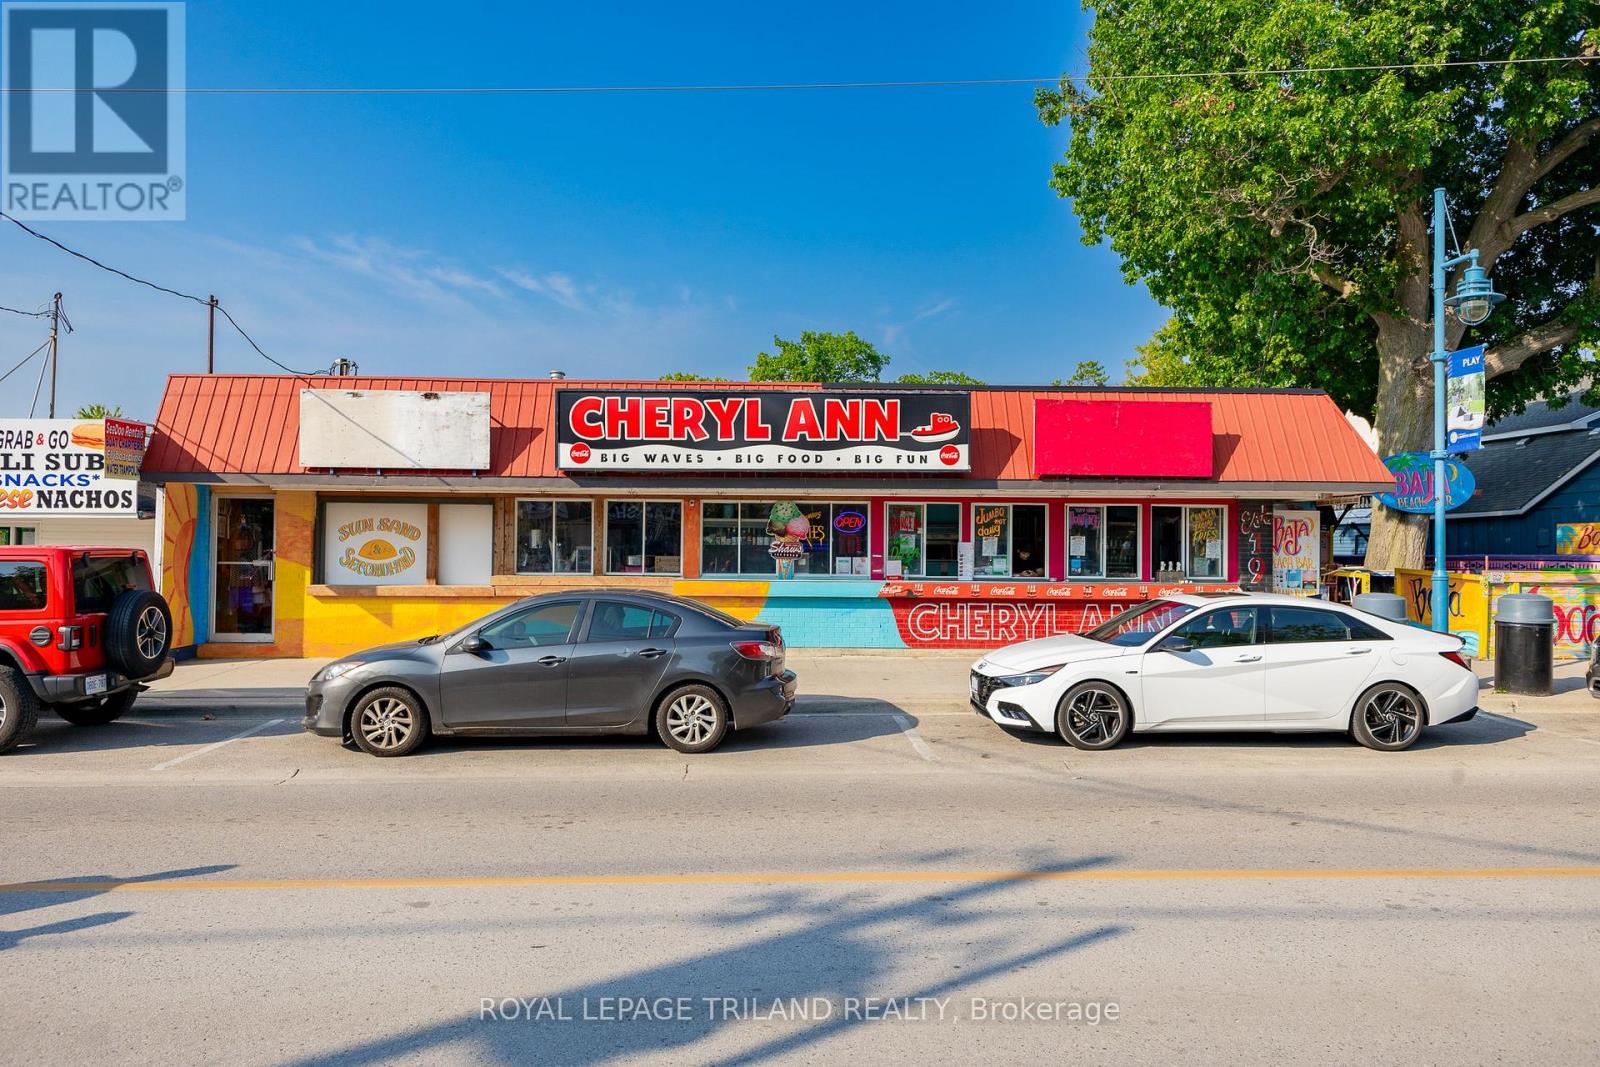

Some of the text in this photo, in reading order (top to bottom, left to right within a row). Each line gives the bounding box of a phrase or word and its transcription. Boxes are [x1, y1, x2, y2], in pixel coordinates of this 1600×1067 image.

[1462, 355, 1481, 368] PLAY
[569, 396, 900, 442] CHERYL ANN
[36, 433, 44, 445] &
[48, 430, 69, 449] GO
[600, 453, 928, 464] BIG WAVES BIG FOOD BIG FUN
[36, 490, 133, 508] NACHOS
[835, 516, 864, 528] OPEN
[976, 507, 1005, 524] JUMBO
[338, 517, 421, 542] SUN SAND
[933, 585, 960, 596] Coca-Cola
[990, 586, 1016, 596] Coca-Cola
[1046, 587, 1072, 597] Coca-Cola
[1102, 587, 1128, 597] Coca-Cola
[908, 603, 1068, 641] CHERYL
